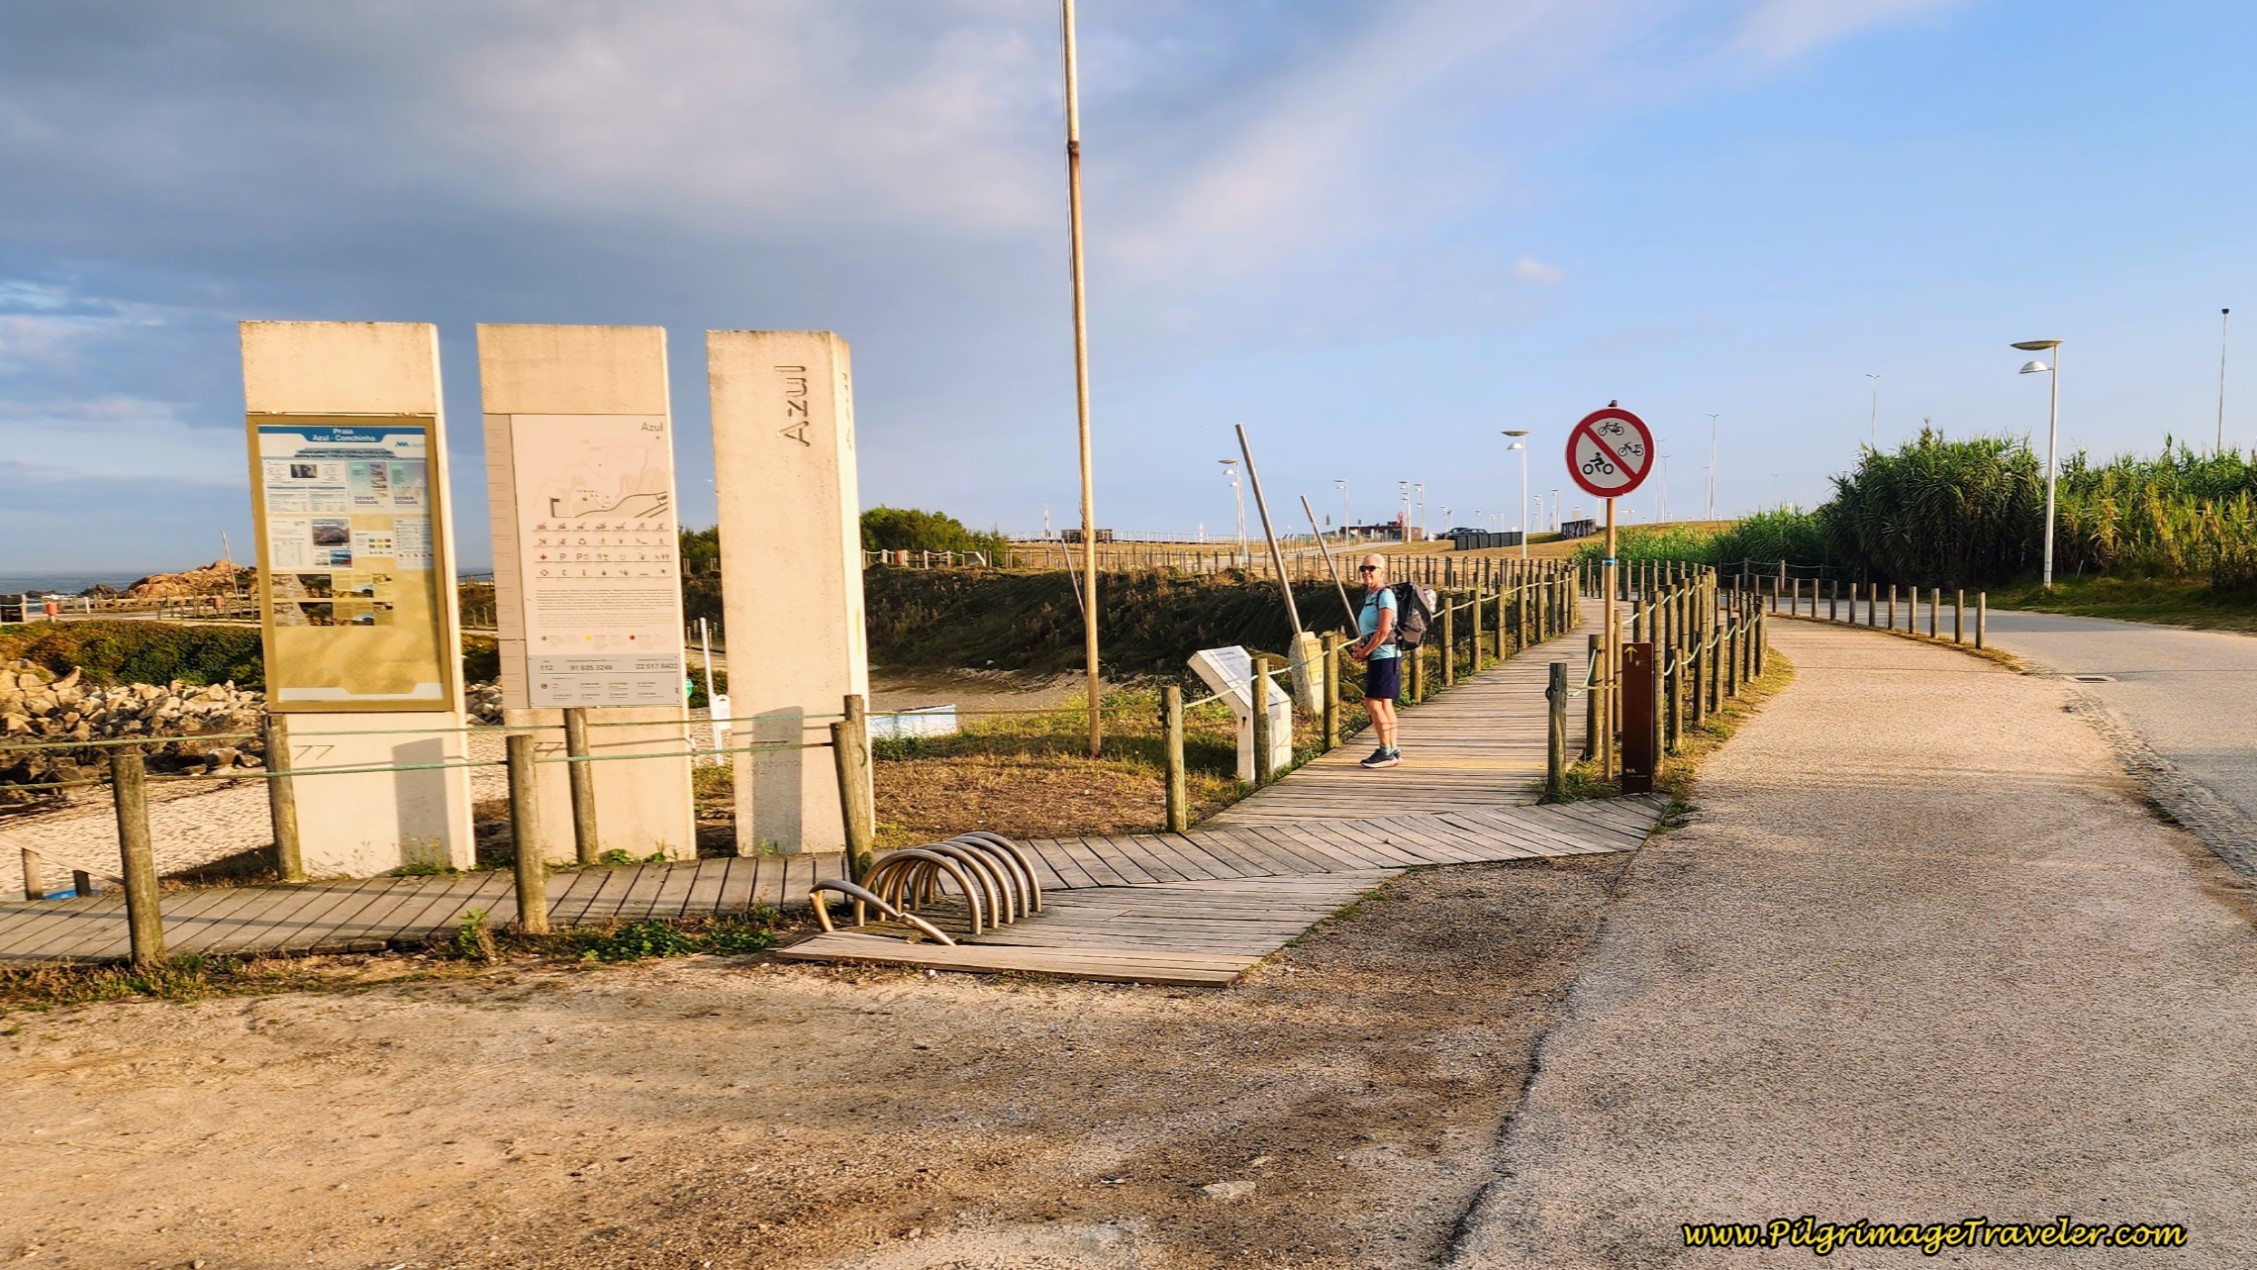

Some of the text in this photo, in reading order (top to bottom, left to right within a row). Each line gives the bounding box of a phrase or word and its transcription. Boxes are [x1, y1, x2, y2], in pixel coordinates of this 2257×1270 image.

[773, 365, 811, 447] Azul
[641, 422, 663, 432] Azul
[293, 744, 335, 761] 77
